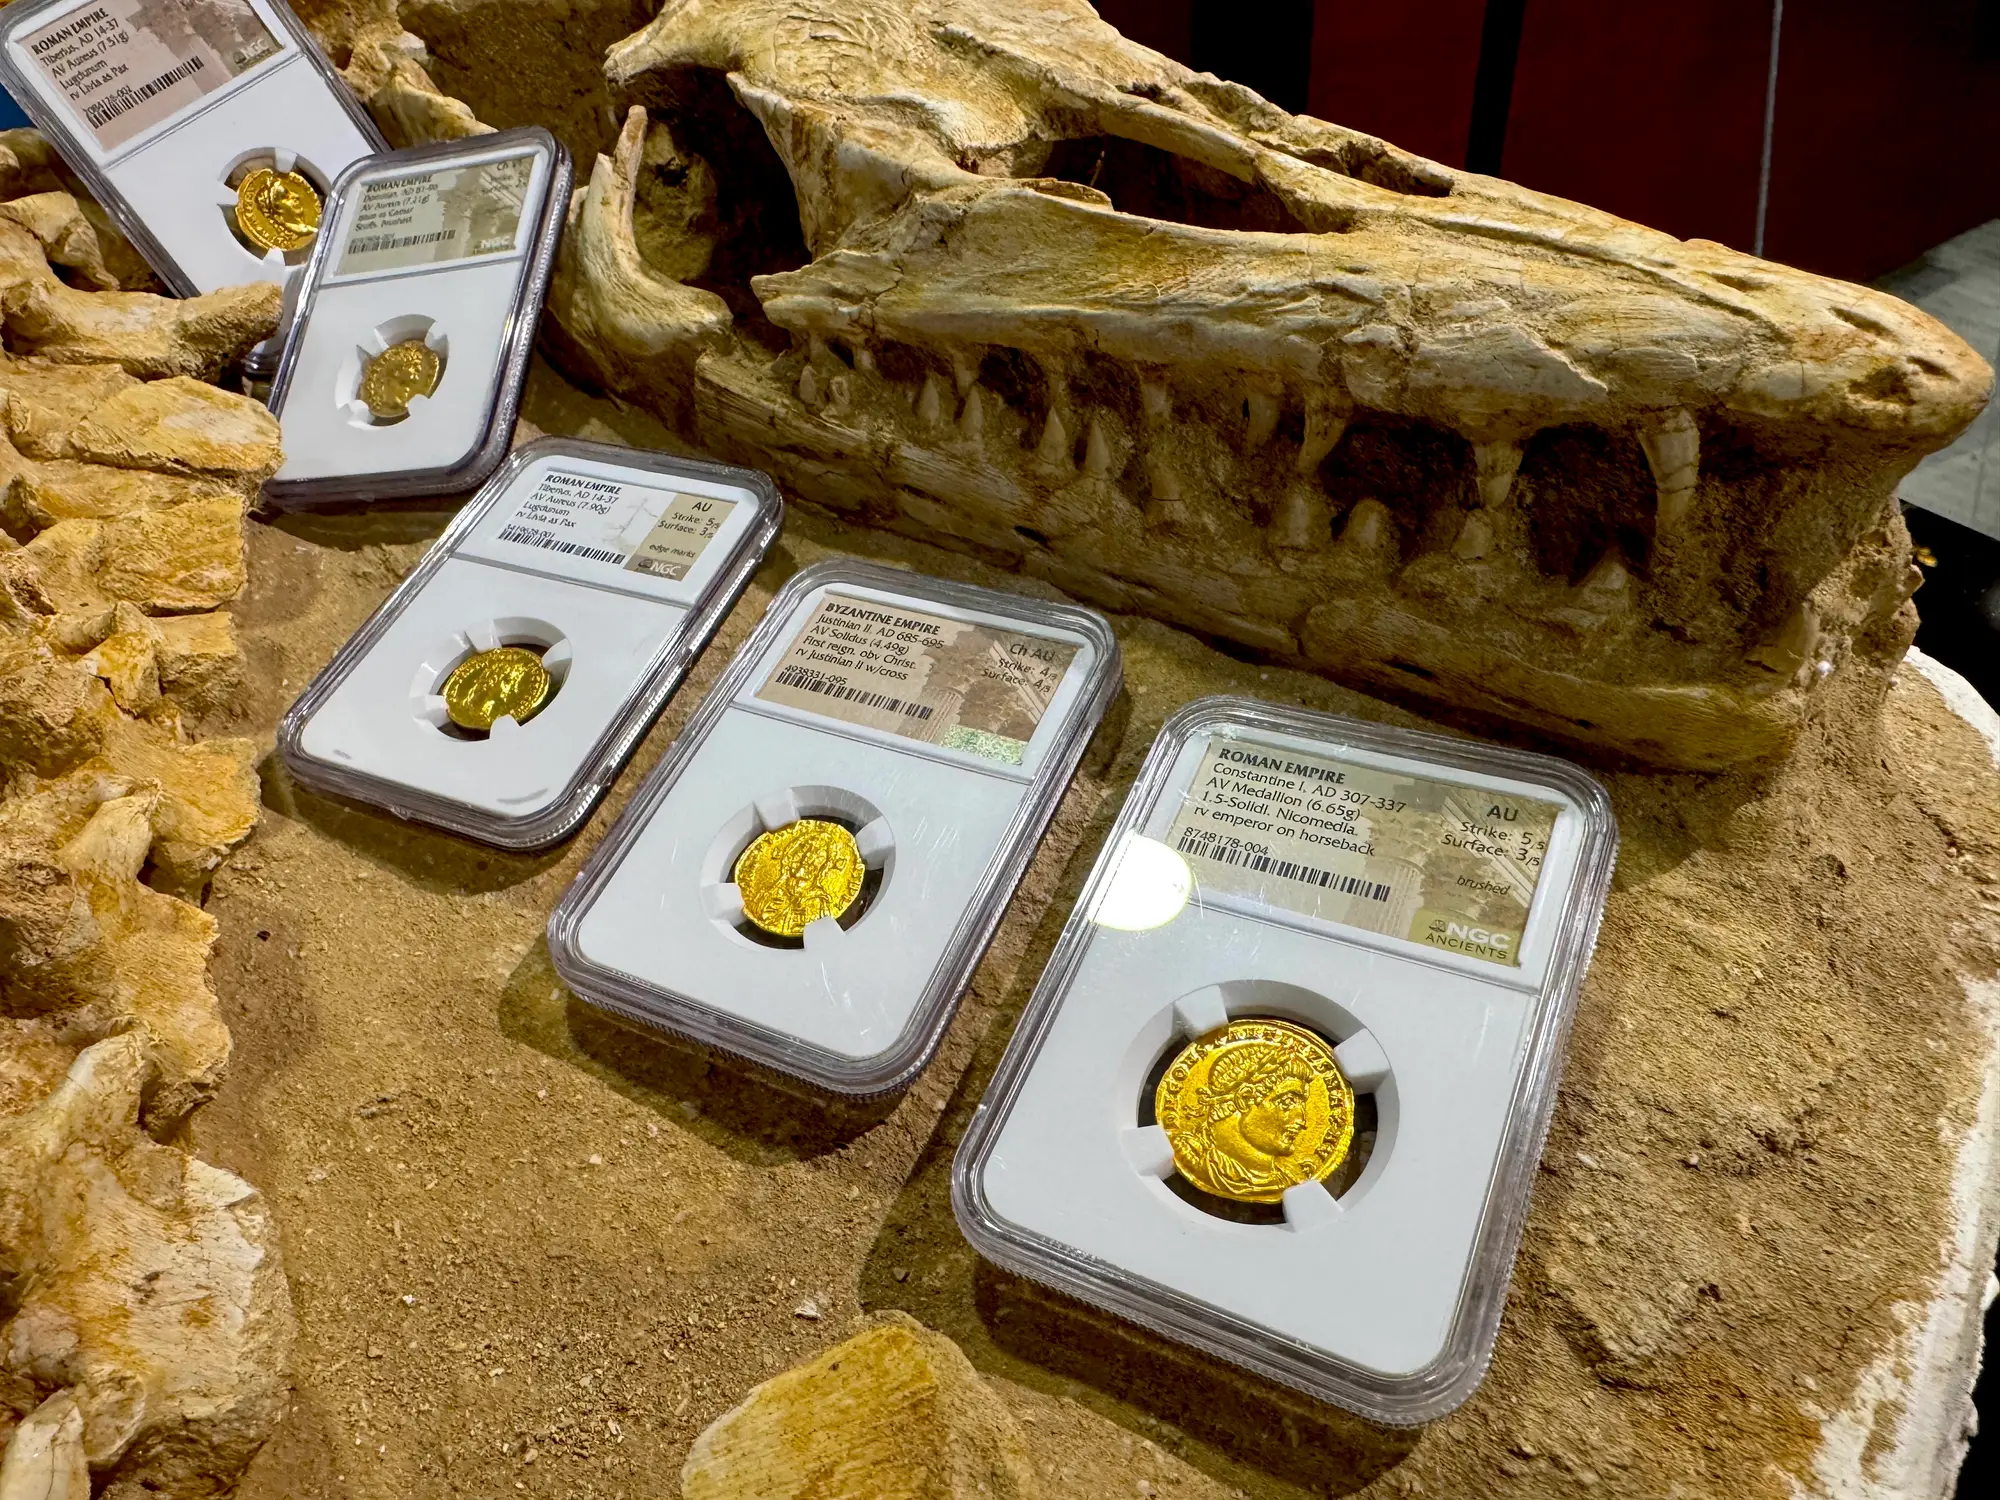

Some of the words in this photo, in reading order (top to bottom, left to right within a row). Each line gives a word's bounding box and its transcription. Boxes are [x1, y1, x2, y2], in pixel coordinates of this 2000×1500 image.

[31, 26, 72, 55] ROMAN
[71, 8, 109, 35] EMPIRE
[79, 34, 94, 47] AD
[95, 18, 119, 37] 14-37
[52, 65, 67, 78] AV
[67, 47, 99, 70] Aureus
[59, 60, 107, 90] Lugdunum
[70, 91, 80, 101] rv
[79, 79, 103, 97] Livia
[103, 73, 113, 83] as
[112, 62, 129, 76] Pax
[366, 181, 400, 193] ROMAN
[400, 175, 433, 187] EMPIRE
[361, 204, 373, 212] AV
[545, 474, 585, 488] ROMAN
[584, 480, 622, 495] EMPIRE
[573, 490, 589, 498] AD
[592, 492, 619, 505] 14-37
[523, 501, 570, 516] Lugdunum
[546, 494, 577, 507] Aureus
[577, 501, 611, 515] (7.90g)
[672, 512, 703, 524] Strike:
[692, 502, 713, 512] AU
[527, 511, 547, 523] Livia
[559, 518, 577, 528] Pax
[658, 520, 697, 534] Surface:
[649, 544, 670, 554] edge
[671, 548, 696, 558] marks
[650, 561, 681, 576] NGC
[816, 613, 862, 631] Justinian
[875, 627, 895, 638] AD
[896, 631, 944, 649] 685-695
[825, 602, 894, 625] BYZANTINE
[893, 617, 940, 636] EMPIRE
[802, 635, 827, 649] First
[860, 649, 880, 661] obv
[883, 653, 917, 670] Christ.
[810, 624, 830, 635] AV
[829, 628, 868, 645] Solidus
[869, 638, 910, 656] (4.49g)
[1009, 643, 1028, 657] Ch
[1030, 648, 1056, 662] AU
[795, 648, 807, 656] rv
[806, 650, 853, 669] Justinian
[854, 660, 865, 670] II
[865, 662, 909, 681] w/cross
[981, 668, 1028, 687] Surface:
[998, 658, 1035, 675] Strike:
[1218, 748, 1285, 773] ROMAN
[1284, 761, 1346, 785] EMPIRE
[1205, 776, 1235, 790] AV
[1231, 781, 1302, 808] Medallion
[1306, 797, 1361, 822] (6.65g)
[1213, 762, 1295, 790] Constantine
[1311, 784, 1337, 798] AD
[1339, 789, 1407, 814] 307-337
[1486, 805, 1519, 822] AU
[1183, 826, 1269, 856] 8748178-004
[1193, 805, 1209, 816] rv
[1211, 809, 1274, 834] emperor
[1276, 825, 1296, 838] on
[1299, 829, 1376, 858] horseback
[1460, 821, 1512, 842] Strike:
[1521, 832, 1545, 850] 5/5
[1441, 833, 1509, 858] Surface:
[1515, 847, 1540, 867] 3/5
[1456, 875, 1511, 896] brushed
[1426, 932, 1508, 960] ANCIENTS
[1445, 921, 1511, 949] NGC
